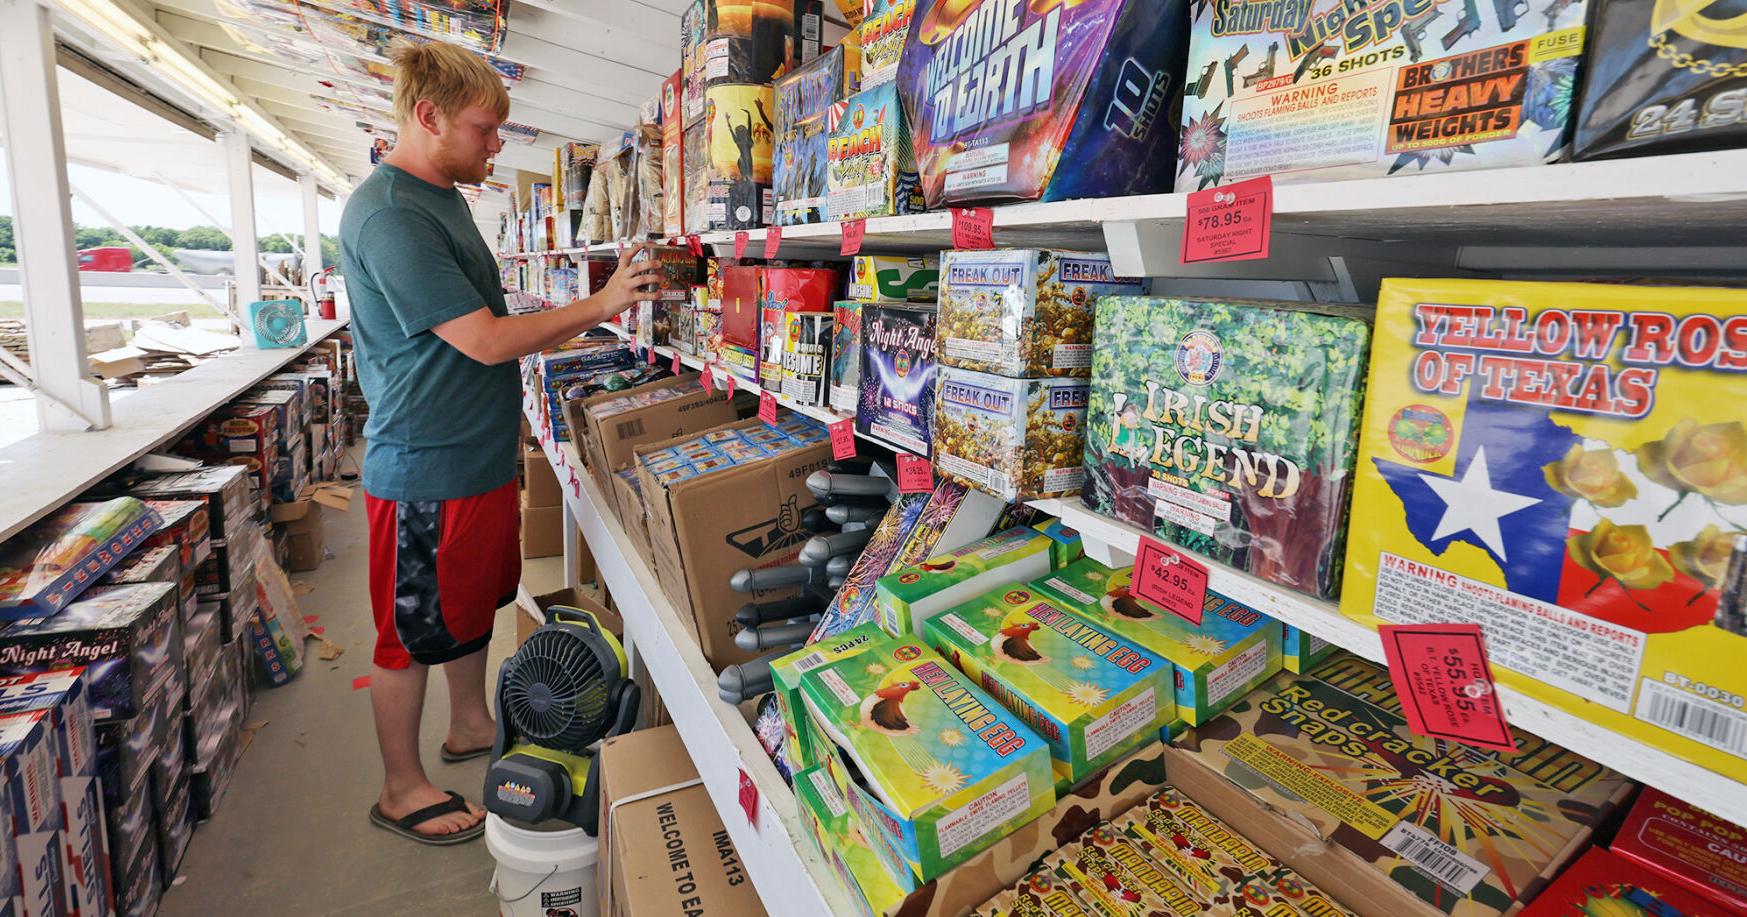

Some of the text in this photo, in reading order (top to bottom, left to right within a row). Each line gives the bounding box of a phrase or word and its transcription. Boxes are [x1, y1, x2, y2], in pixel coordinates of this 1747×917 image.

[863, 0, 916, 47] BEACH
[1214, 0, 1311, 34] Saturday
[927, 0, 1020, 100] WELCOME
[1537, 32, 1579, 49] FUSE
[931, 84, 952, 143] TO
[953, 7, 1061, 133] EARTH
[1311, 45, 1405, 79] 36 SHOTS
[1103, 57, 1152, 138] 10
[1132, 70, 1172, 142] SHOTS
[1237, 86, 1377, 123] SHOOTS FLAMING BALLS AND REPORTS
[1271, 83, 1338, 105] WARNING
[1395, 71, 1522, 120] HEAVY
[1396, 108, 1511, 142] WEIGHTS
[1630, 98, 1697, 138] 24
[828, 123, 882, 161] BEACH
[1392, 143, 1402, 151] UP
[1404, 140, 1419, 149] TO
[1449, 136, 1462, 145] OF
[1464, 129, 1512, 143] POWDER
[909, 195, 925, 207] 500
[1198, 211, 1241, 230] $78.95
[1196, 232, 1231, 244] SATURDAY
[951, 267, 1020, 286] FREAK OUT
[1063, 263, 1109, 282] FREAK
[869, 319, 937, 360] Night Ange
[1416, 303, 1747, 368] YELLOW ROS
[945, 385, 1010, 411] FREAK OUT
[1053, 388, 1089, 407] FREA
[1416, 350, 1658, 418] OF TEXAS
[1142, 380, 1264, 443] IRISH
[1107, 392, 1301, 499] LEGEND
[1162, 472, 1190, 488] SHOTS
[1151, 564, 1189, 592] $42.95
[1168, 591, 1194, 609] LEGEND
[1215, 603, 1262, 627] EGG
[1384, 554, 1457, 588] WARNING
[1494, 592, 1535, 614] FLAMING
[1535, 605, 1566, 624] BALLS
[1567, 615, 1588, 631] AND
[1589, 622, 1639, 648] REPORTS
[1025, 602, 1152, 675] HEN LAYING EGG
[1549, 621, 1590, 641] OUTDOOR
[0, 640, 117, 667] Night Angel
[1426, 678, 1440, 706] TEXAS
[1443, 647, 1477, 712] $55.95
[910, 661, 1027, 758] HEN LAYING EGG
[1038, 710, 1060, 743] EGG
[1262, 698, 1368, 757] Snaps
[1347, 715, 1504, 797] cracker
[968, 790, 998, 811] CAUTION
[1145, 813, 1177, 839] Snaps
[1699, 820, 1744, 842] POP
[655, 801, 699, 896] WELCOME TO
[712, 829, 744, 887] IMA113
[1075, 850, 1107, 880] Snaps
[1707, 842, 1747, 864] CAU
